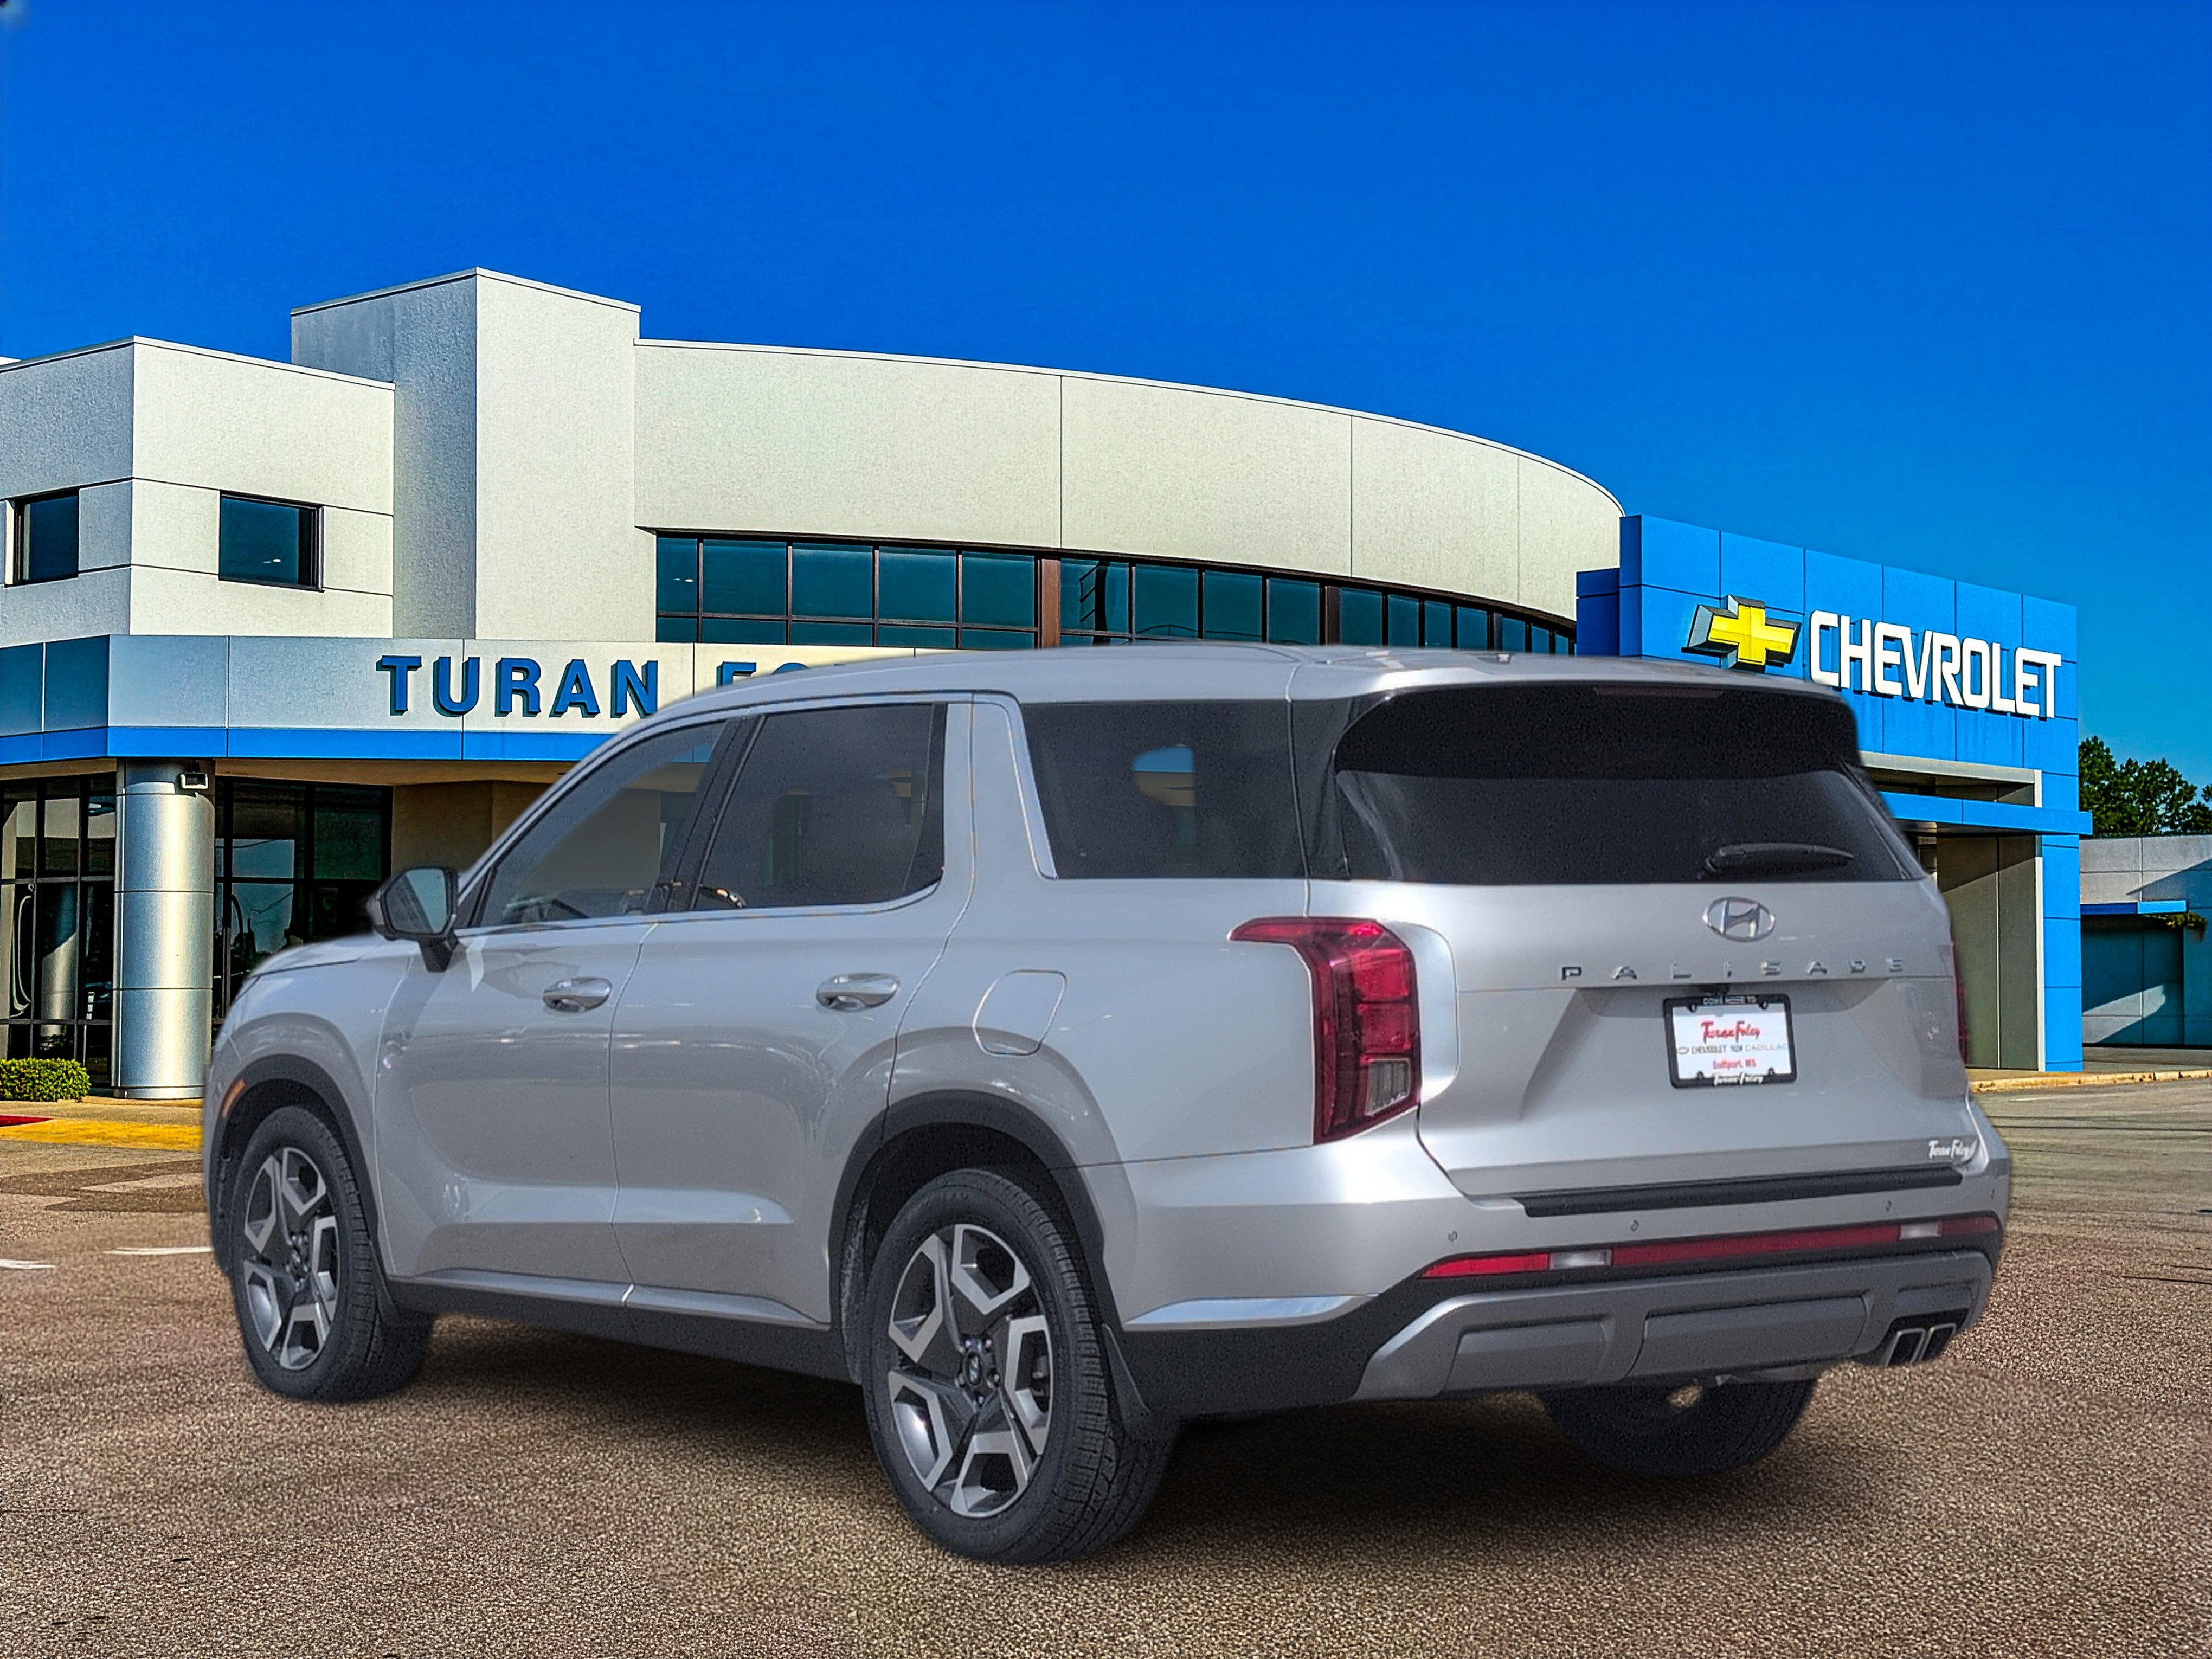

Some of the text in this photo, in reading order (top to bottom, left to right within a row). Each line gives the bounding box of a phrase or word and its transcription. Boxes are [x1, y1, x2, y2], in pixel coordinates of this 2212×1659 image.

[376, 655, 658, 718] TURAN
[1810, 610, 2062, 718] CHEVROLET
[1560, 957, 1905, 981] PALISADE
